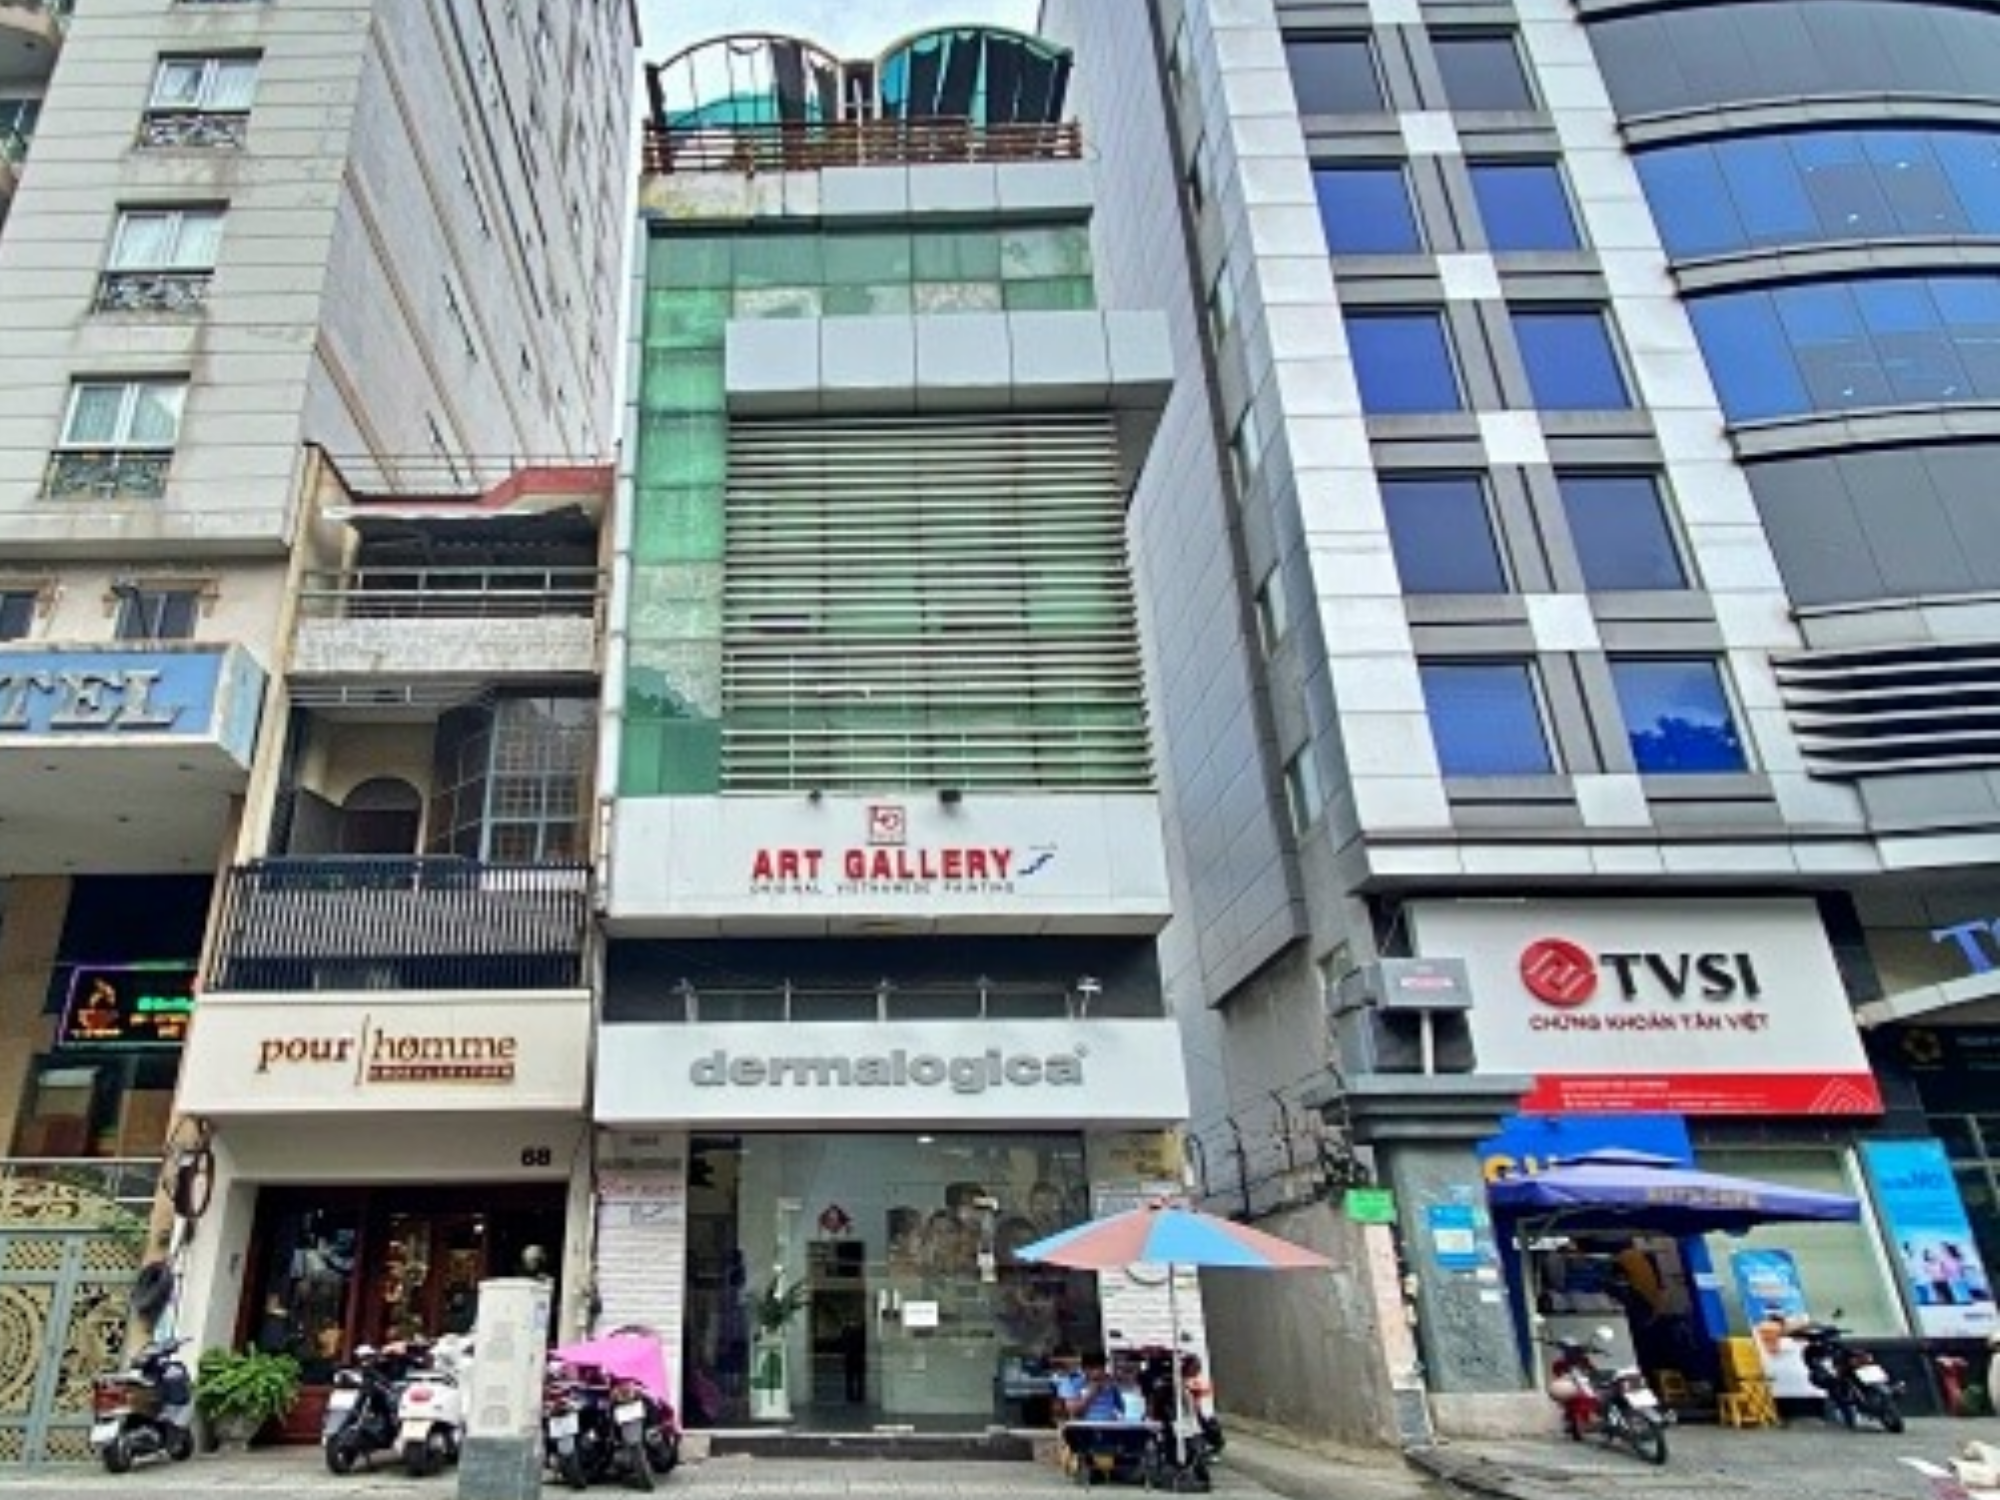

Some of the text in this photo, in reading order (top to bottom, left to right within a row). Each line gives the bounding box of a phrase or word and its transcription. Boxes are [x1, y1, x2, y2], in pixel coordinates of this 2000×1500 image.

[752, 849, 1012, 879] ART GALLERY
[1600, 952, 1762, 1002] TVSI
[255, 1036, 354, 1074] pour
[689, 1049, 1083, 1095] dermalogica
